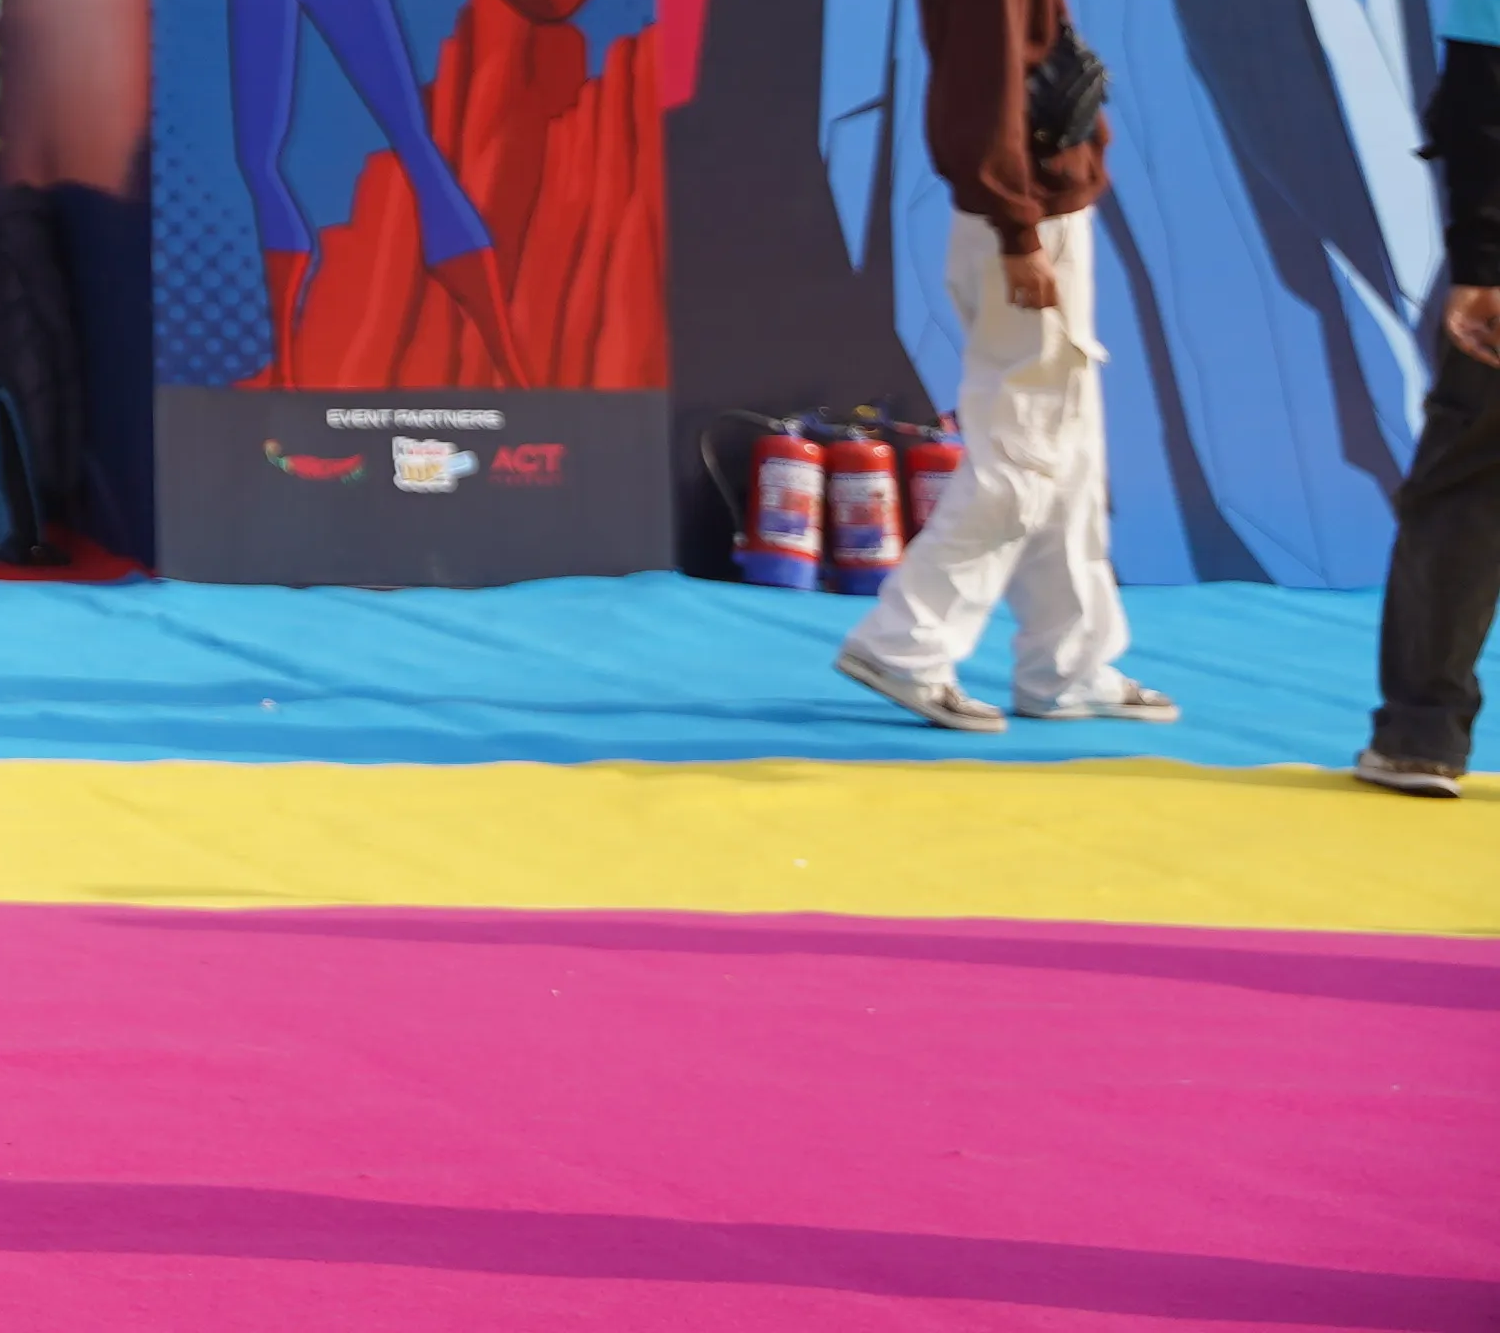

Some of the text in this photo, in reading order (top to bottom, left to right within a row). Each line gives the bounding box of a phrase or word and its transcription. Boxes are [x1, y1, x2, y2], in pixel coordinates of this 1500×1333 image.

[326, 408, 505, 431] EVENT PARTNERS
[490, 442, 567, 473] ACT
